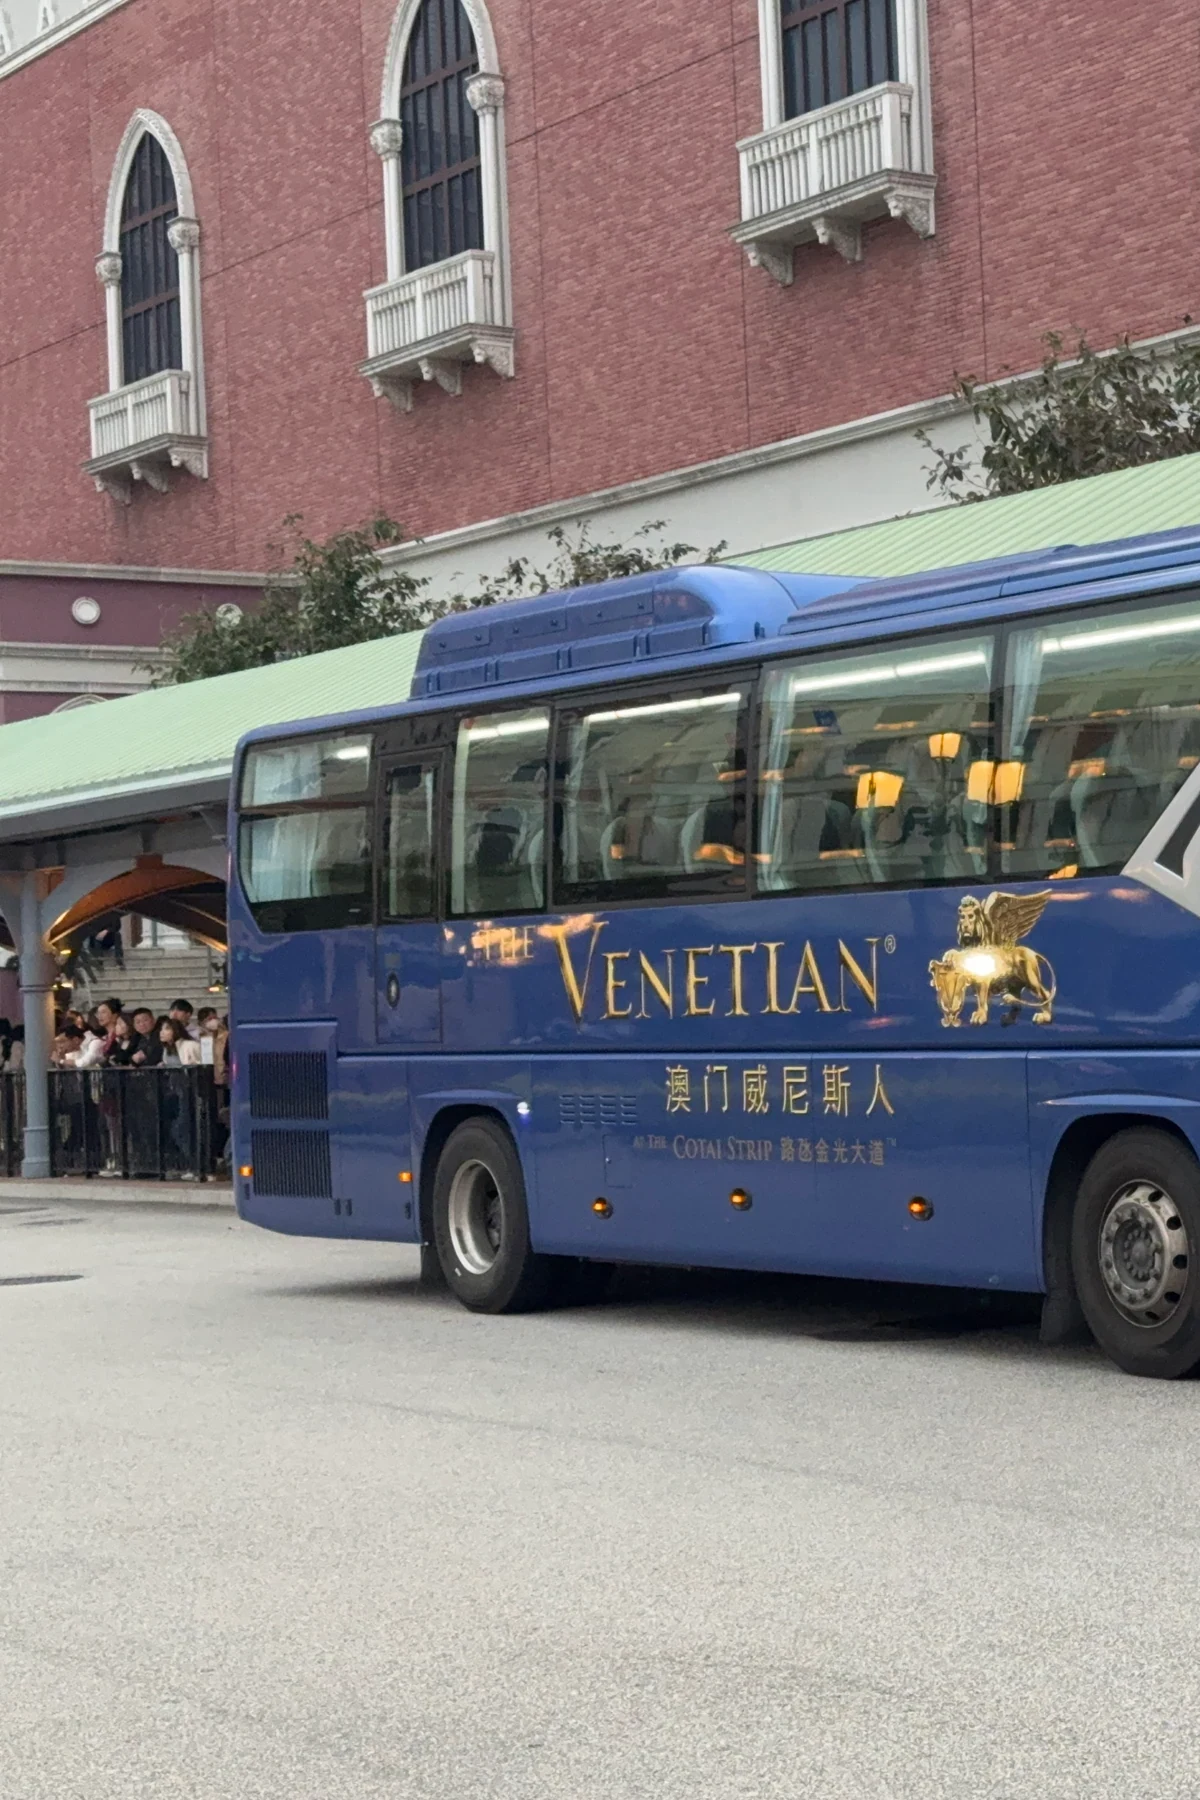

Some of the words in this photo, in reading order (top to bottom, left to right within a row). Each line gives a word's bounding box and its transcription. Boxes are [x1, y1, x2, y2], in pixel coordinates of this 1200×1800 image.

[666, 1063, 895, 1118] 澳门威尼斯人
[672, 1134, 722, 1161] COTAI
[726, 1135, 773, 1162] STRIP
